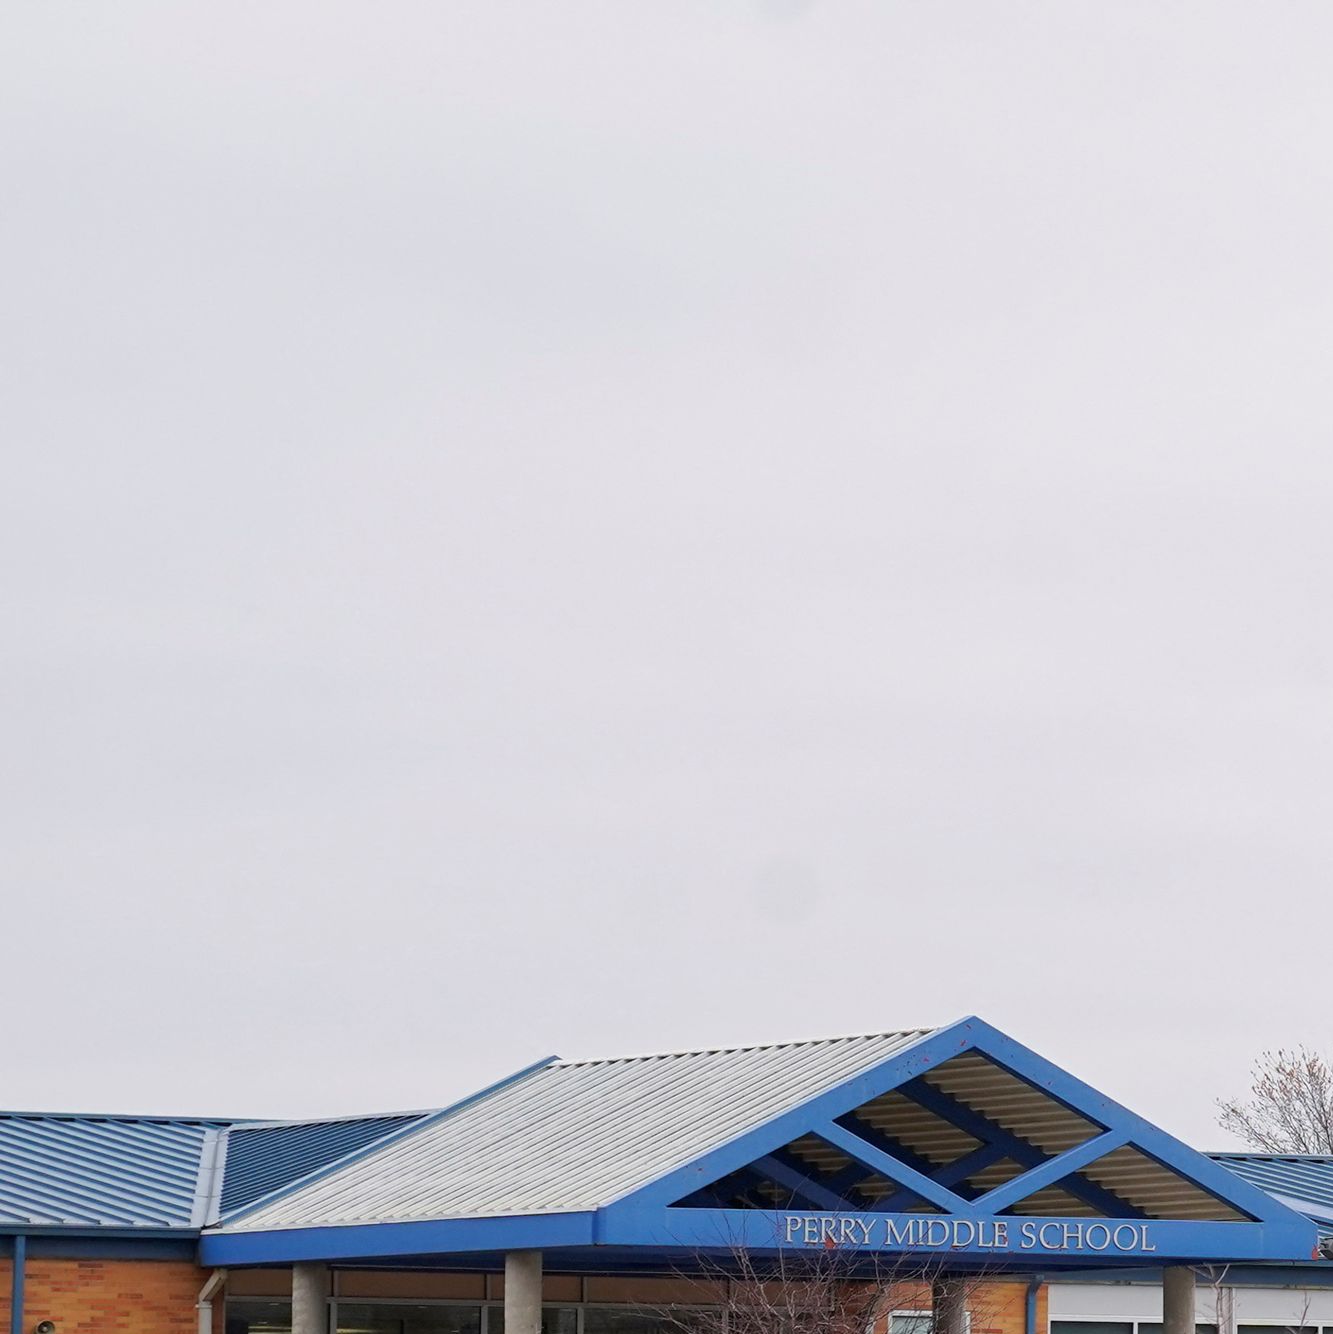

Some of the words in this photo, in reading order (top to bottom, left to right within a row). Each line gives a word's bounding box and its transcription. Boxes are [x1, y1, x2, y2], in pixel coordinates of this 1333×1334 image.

[785, 1216, 877, 1246] PERRY
[885, 1219, 1009, 1249] MIDDLE
[1020, 1221, 1156, 1252] SCHOOL
